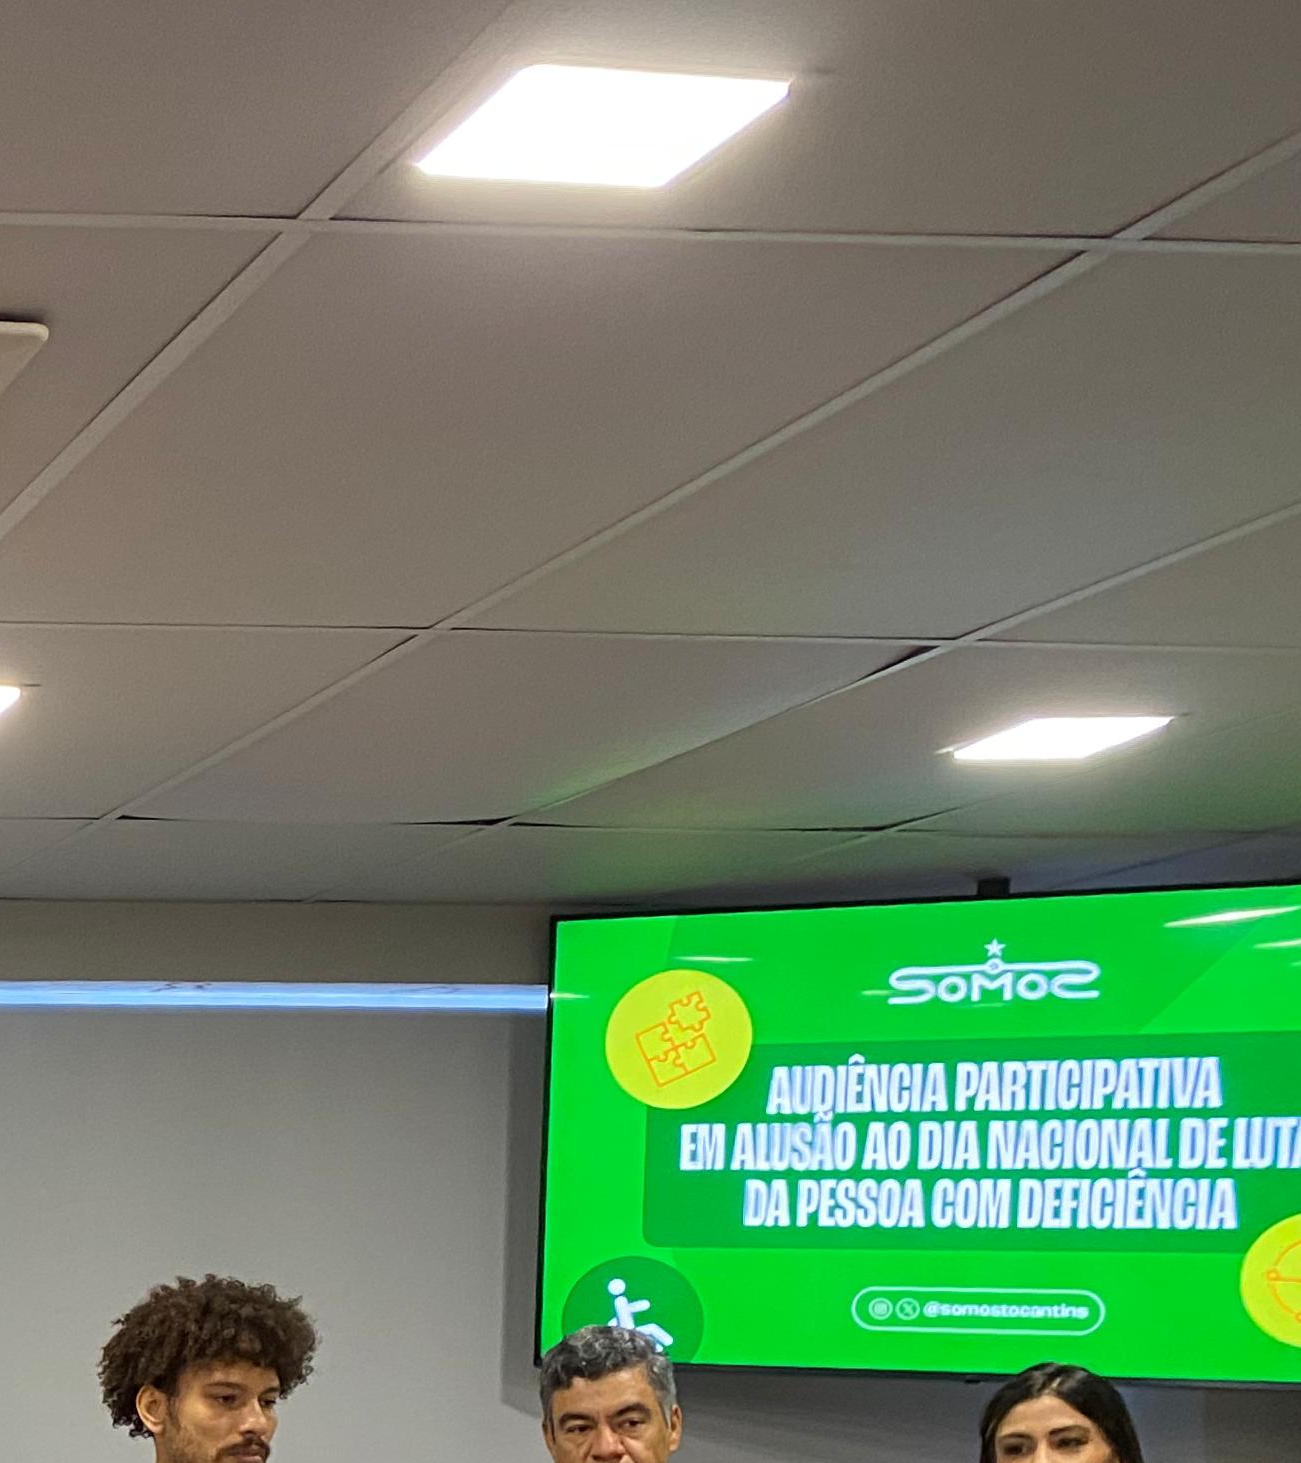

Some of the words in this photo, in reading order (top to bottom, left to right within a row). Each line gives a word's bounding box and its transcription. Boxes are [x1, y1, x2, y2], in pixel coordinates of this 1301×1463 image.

[765, 1053, 949, 1115] AUDIÊNCIA
[954, 1057, 1224, 1111] PARTICIPATIVA
[679, 1123, 727, 1171] EM
[730, 1110, 858, 1171] ALUSÃO
[861, 1121, 912, 1171] AO
[917, 1120, 981, 1170] DIA
[987, 1117, 1173, 1169] NACIONAL
[1178, 1117, 1230, 1169] DE
[743, 1178, 791, 1227] DA
[796, 1178, 926, 1228] PESSOA
[931, 1178, 1012, 1229] COM
[1017, 1167, 1239, 1230] DEFICIÊNCIA
[923, 1301, 1089, 1319] @somostocantins
